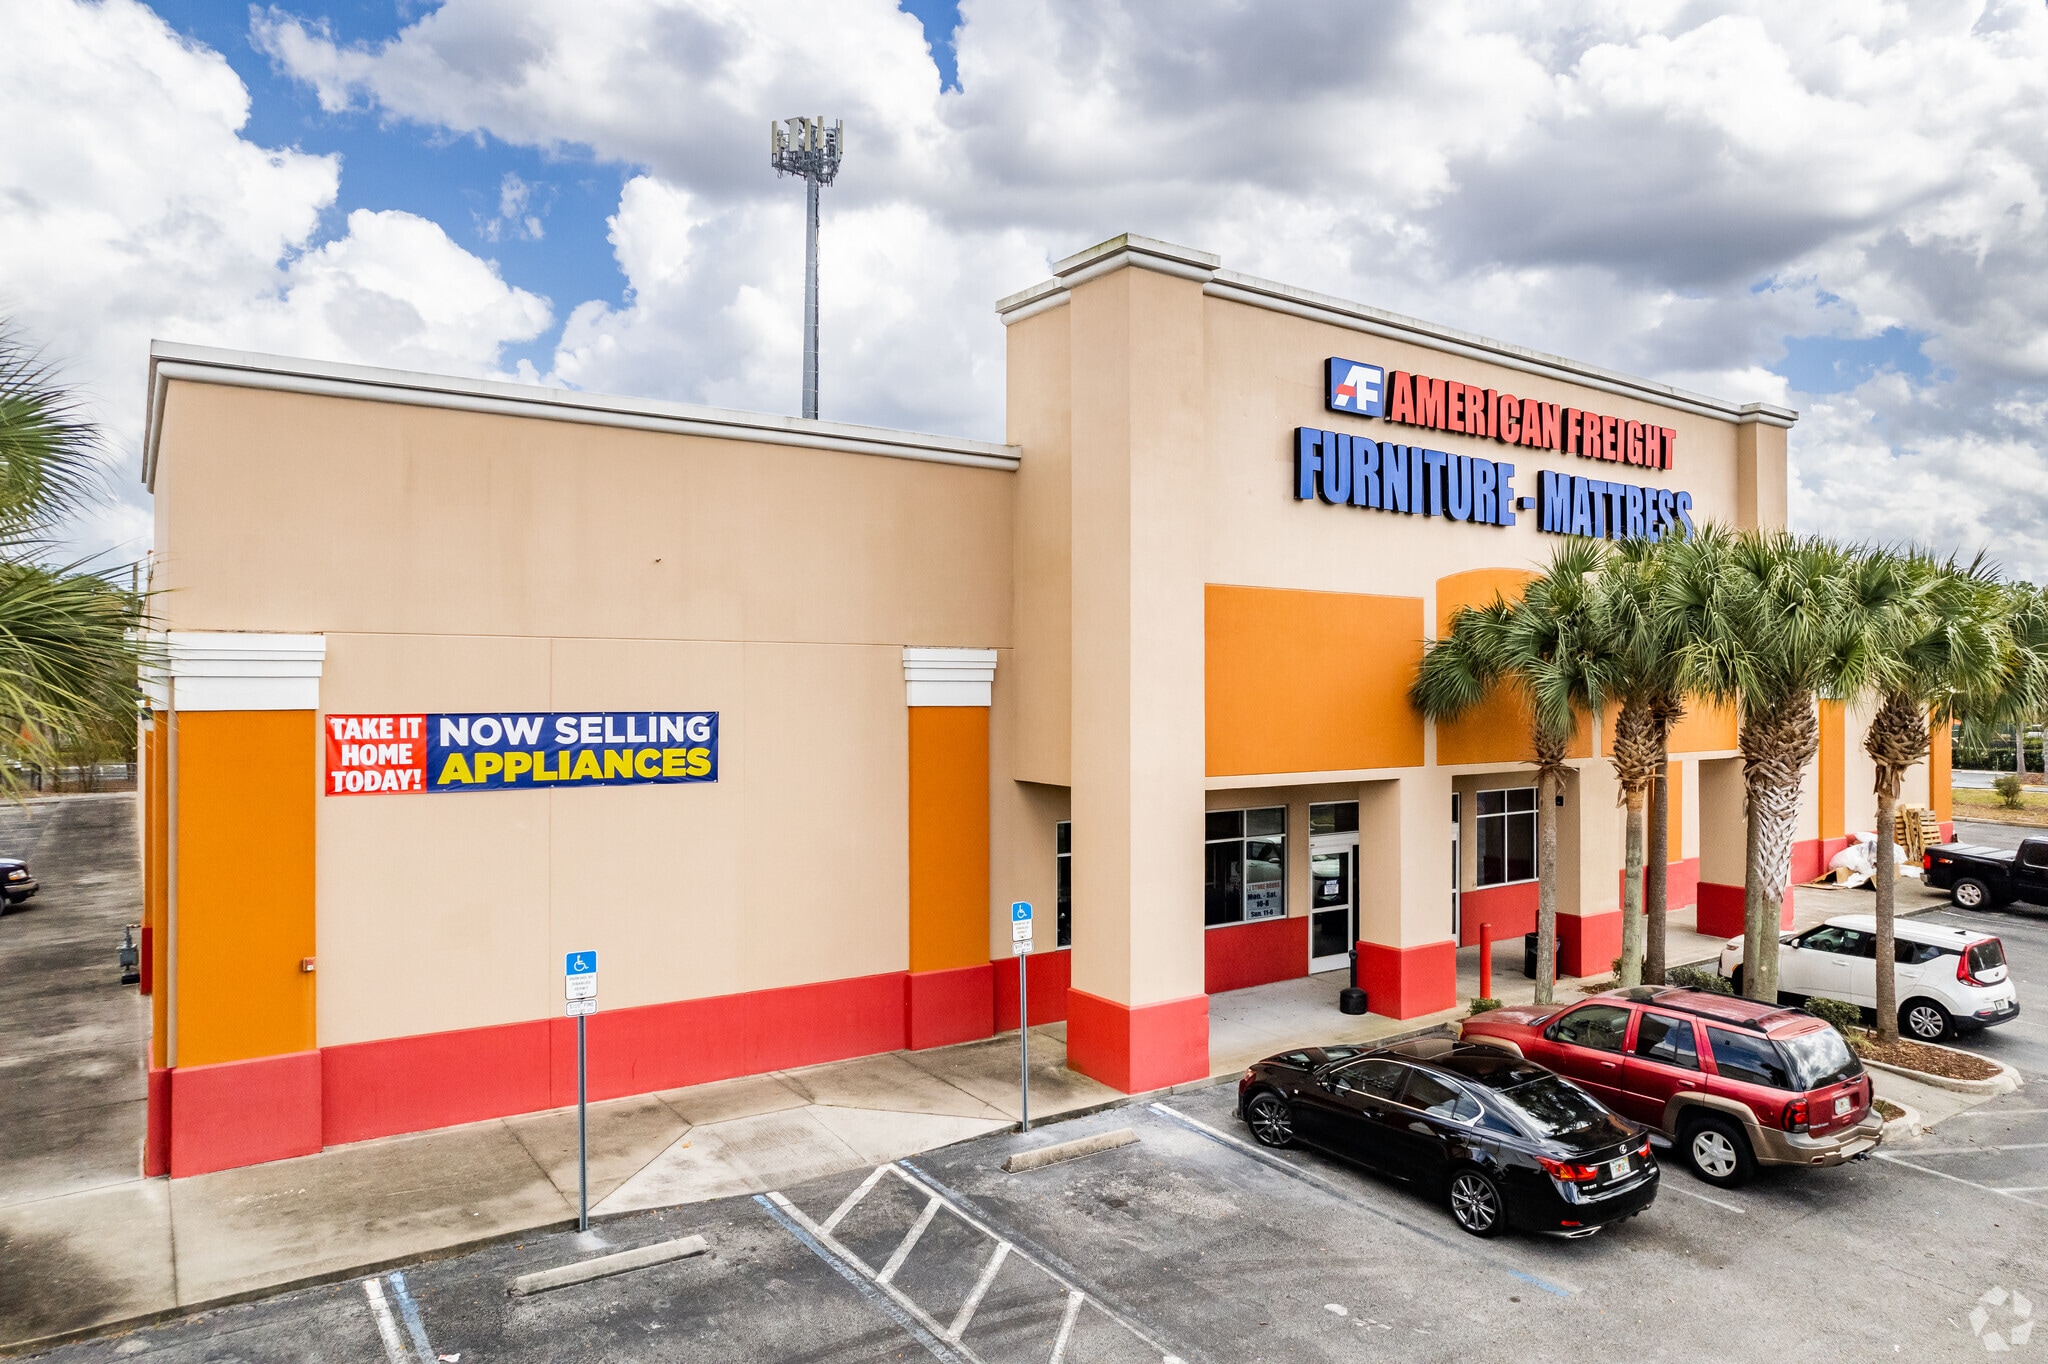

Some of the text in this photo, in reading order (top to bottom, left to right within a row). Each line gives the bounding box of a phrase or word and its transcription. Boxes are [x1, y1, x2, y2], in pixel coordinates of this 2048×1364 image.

[1333, 364, 1381, 412] AF
[1388, 370, 1677, 471] AMERICAN FREIGHT
[1295, 426, 1516, 527] FURNITURE
[1538, 469, 1694, 545] MATTRESS
[330, 717, 422, 740] TAKE IT
[439, 715, 711, 747] NOW SELLING
[341, 743, 413, 767] HOME
[436, 747, 712, 785] APPLIANCES
[331, 768, 422, 793] TODAY!
[1247, 893, 1262, 901] Mon.
[1266, 891, 1278, 899] Sat.
